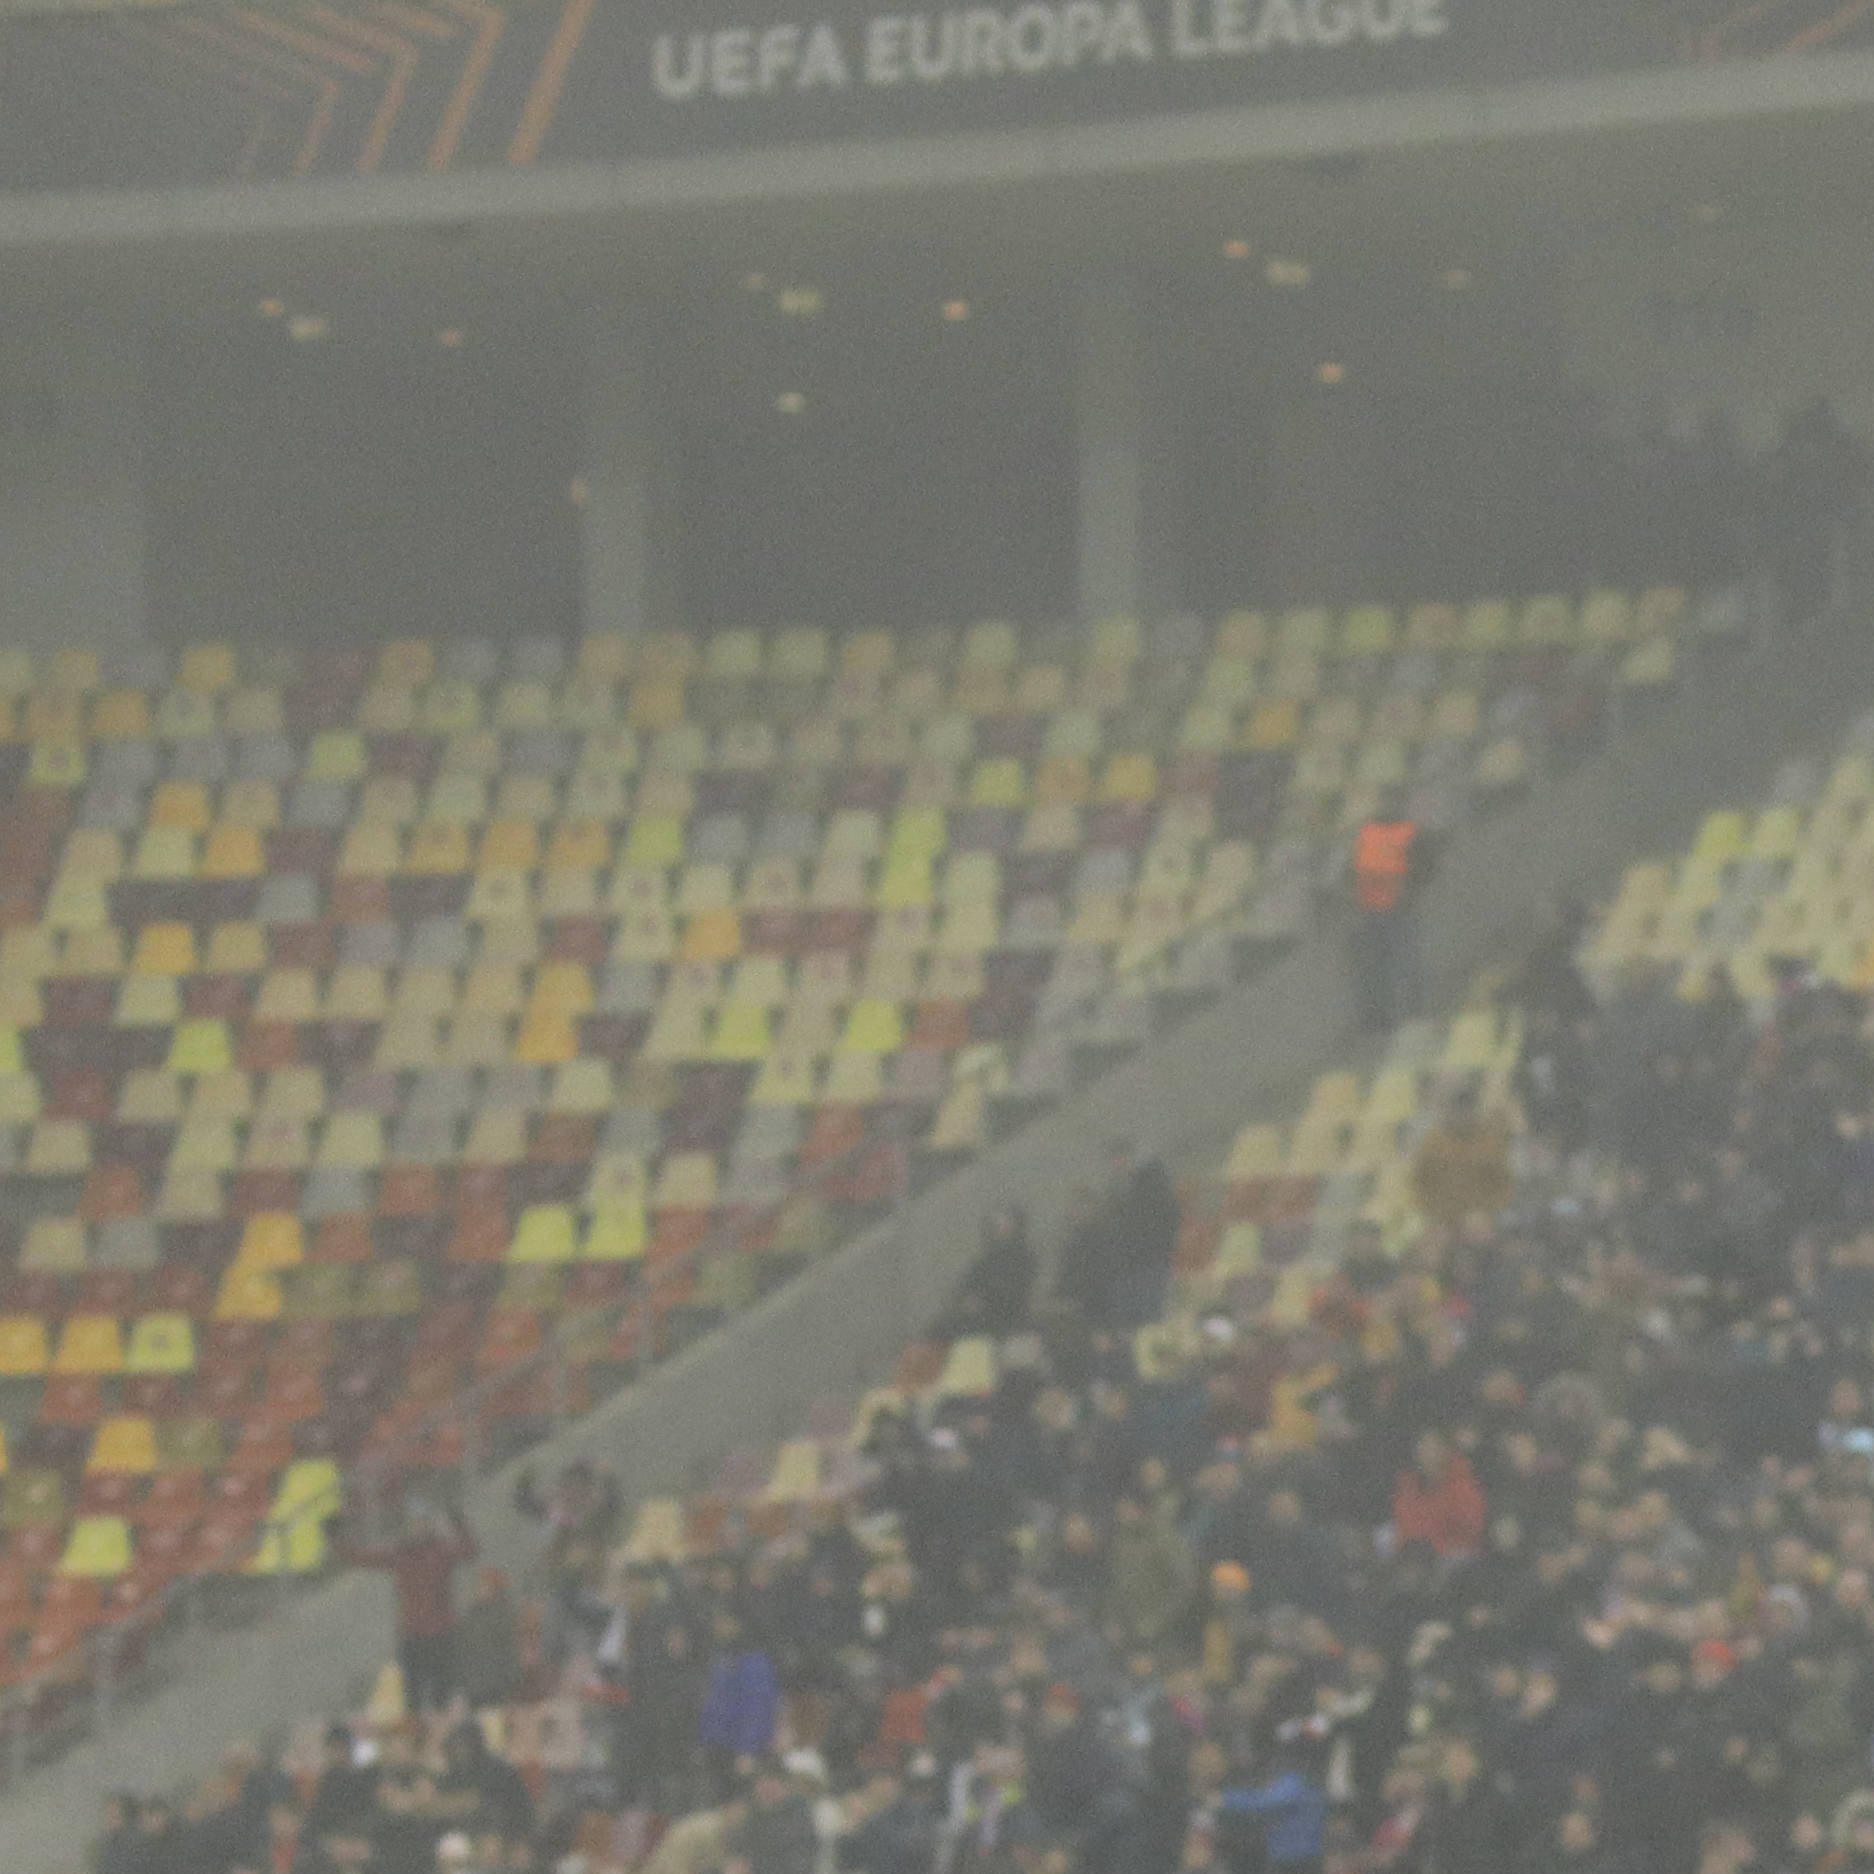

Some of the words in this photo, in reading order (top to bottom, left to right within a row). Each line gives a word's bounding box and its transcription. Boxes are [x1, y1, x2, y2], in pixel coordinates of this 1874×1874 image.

[652, 26, 848, 98] UEFA
[865, 0, 1154, 87] EUROPA
[1172, 0, 1452, 59] LEAGUE
